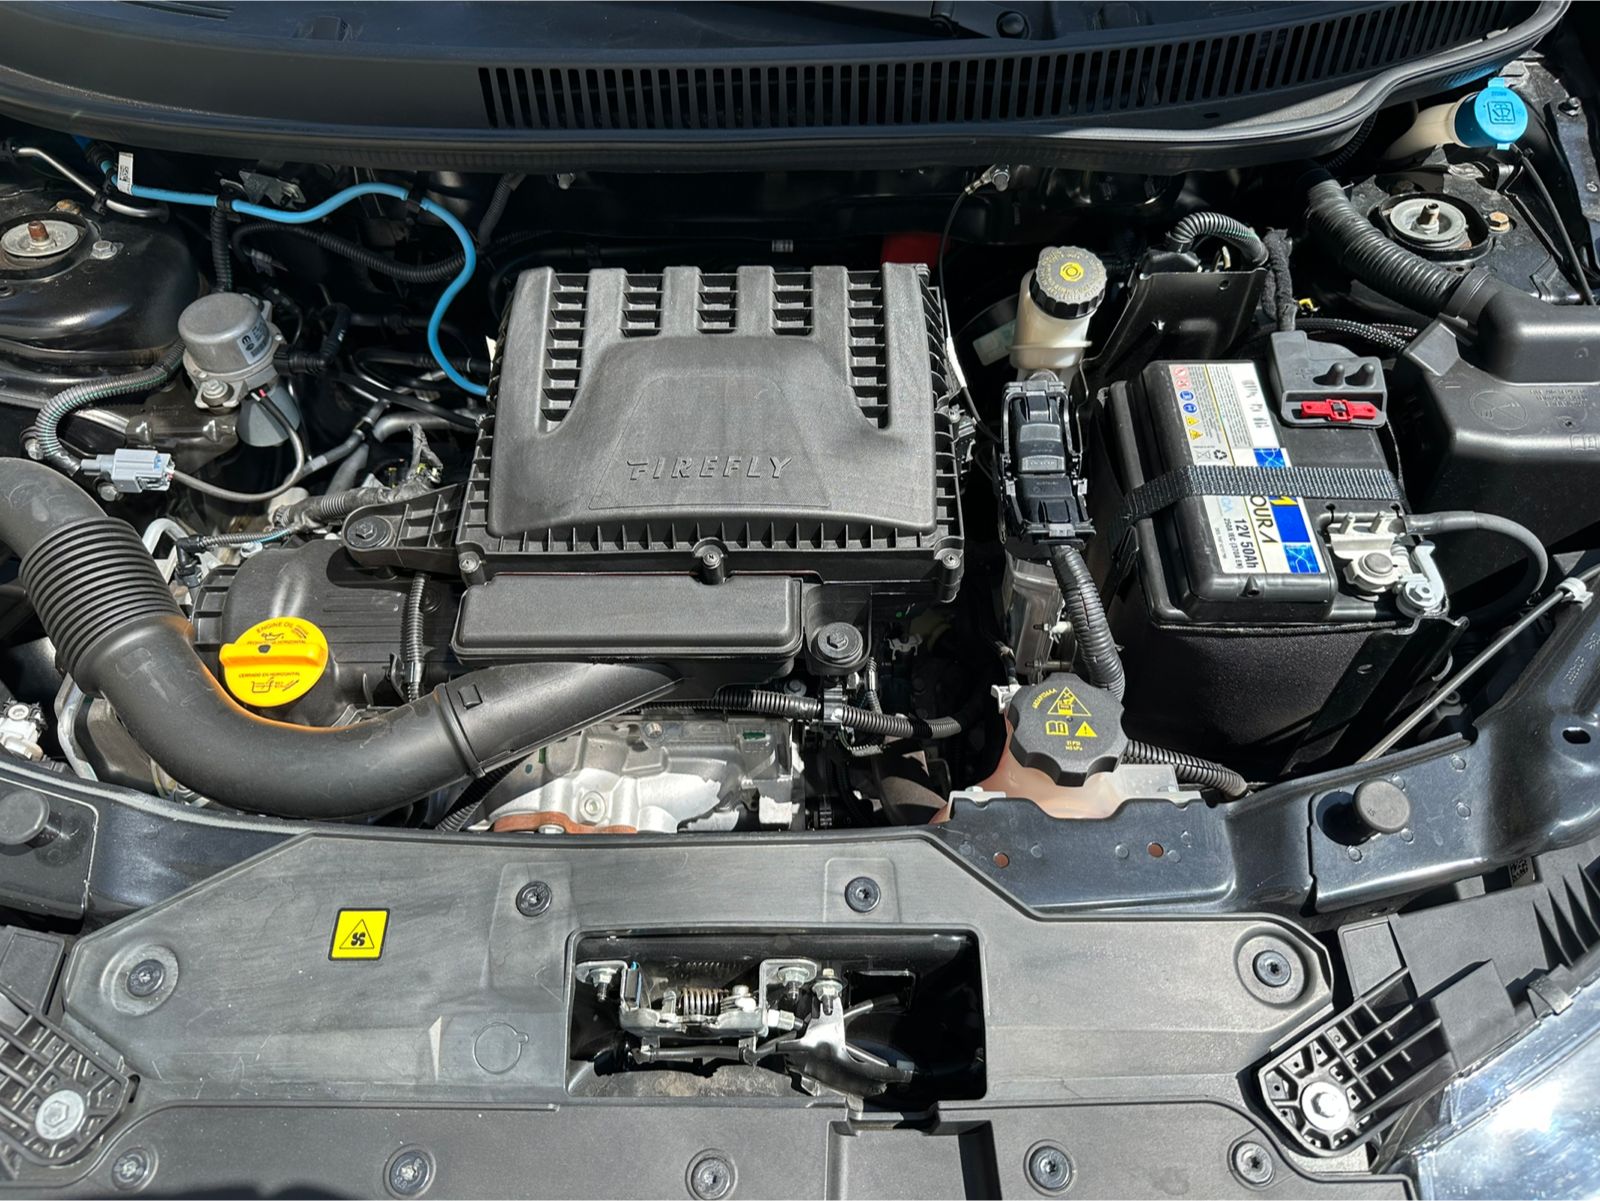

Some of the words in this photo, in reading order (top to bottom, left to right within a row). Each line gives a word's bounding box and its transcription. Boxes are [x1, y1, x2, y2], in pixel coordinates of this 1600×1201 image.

[626, 455, 793, 481] FIREFLY
[1233, 518, 1251, 538] 12V
[1248, 495, 1279, 543] OURA
[1240, 541, 1259, 569] 50Ah
[256, 622, 282, 634] ENGINE
